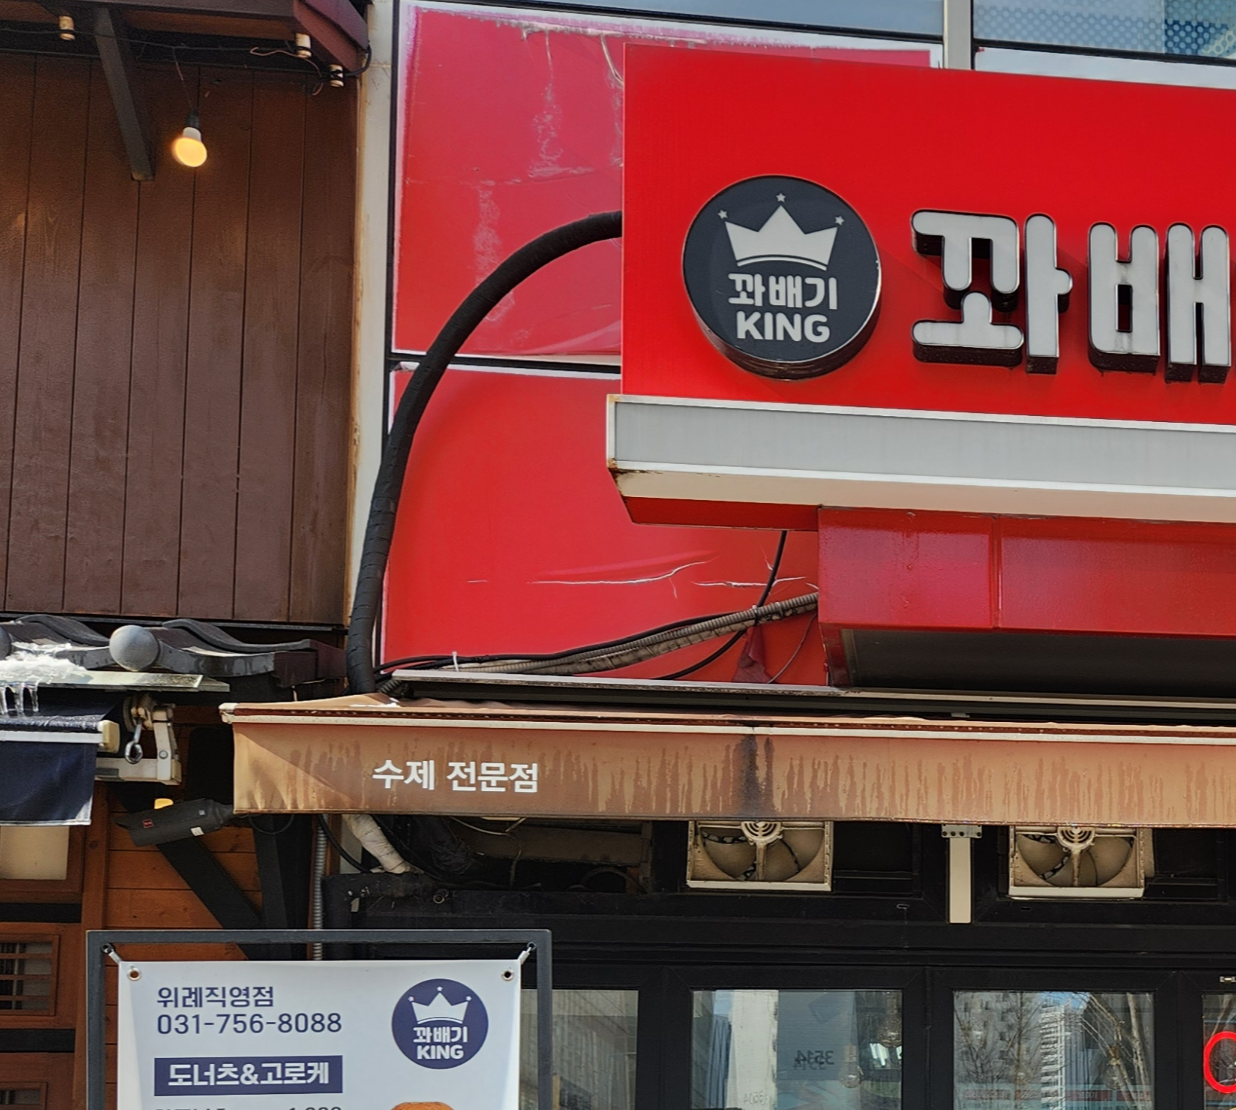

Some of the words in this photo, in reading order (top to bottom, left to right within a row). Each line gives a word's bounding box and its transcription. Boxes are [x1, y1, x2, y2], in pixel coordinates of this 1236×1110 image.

[727, 272, 838, 310] 꽈배기
[736, 311, 831, 343] KING
[371, 759, 435, 791] 수제
[446, 761, 539, 793] 전문점
[156, 986, 275, 1009] 위례직영점
[156, 1011, 342, 1035] 031-756-8088
[412, 1025, 468, 1044] 꽈배기
[416, 1044, 465, 1060] KING
[168, 1061, 329, 1087] 도너츠&고로케
